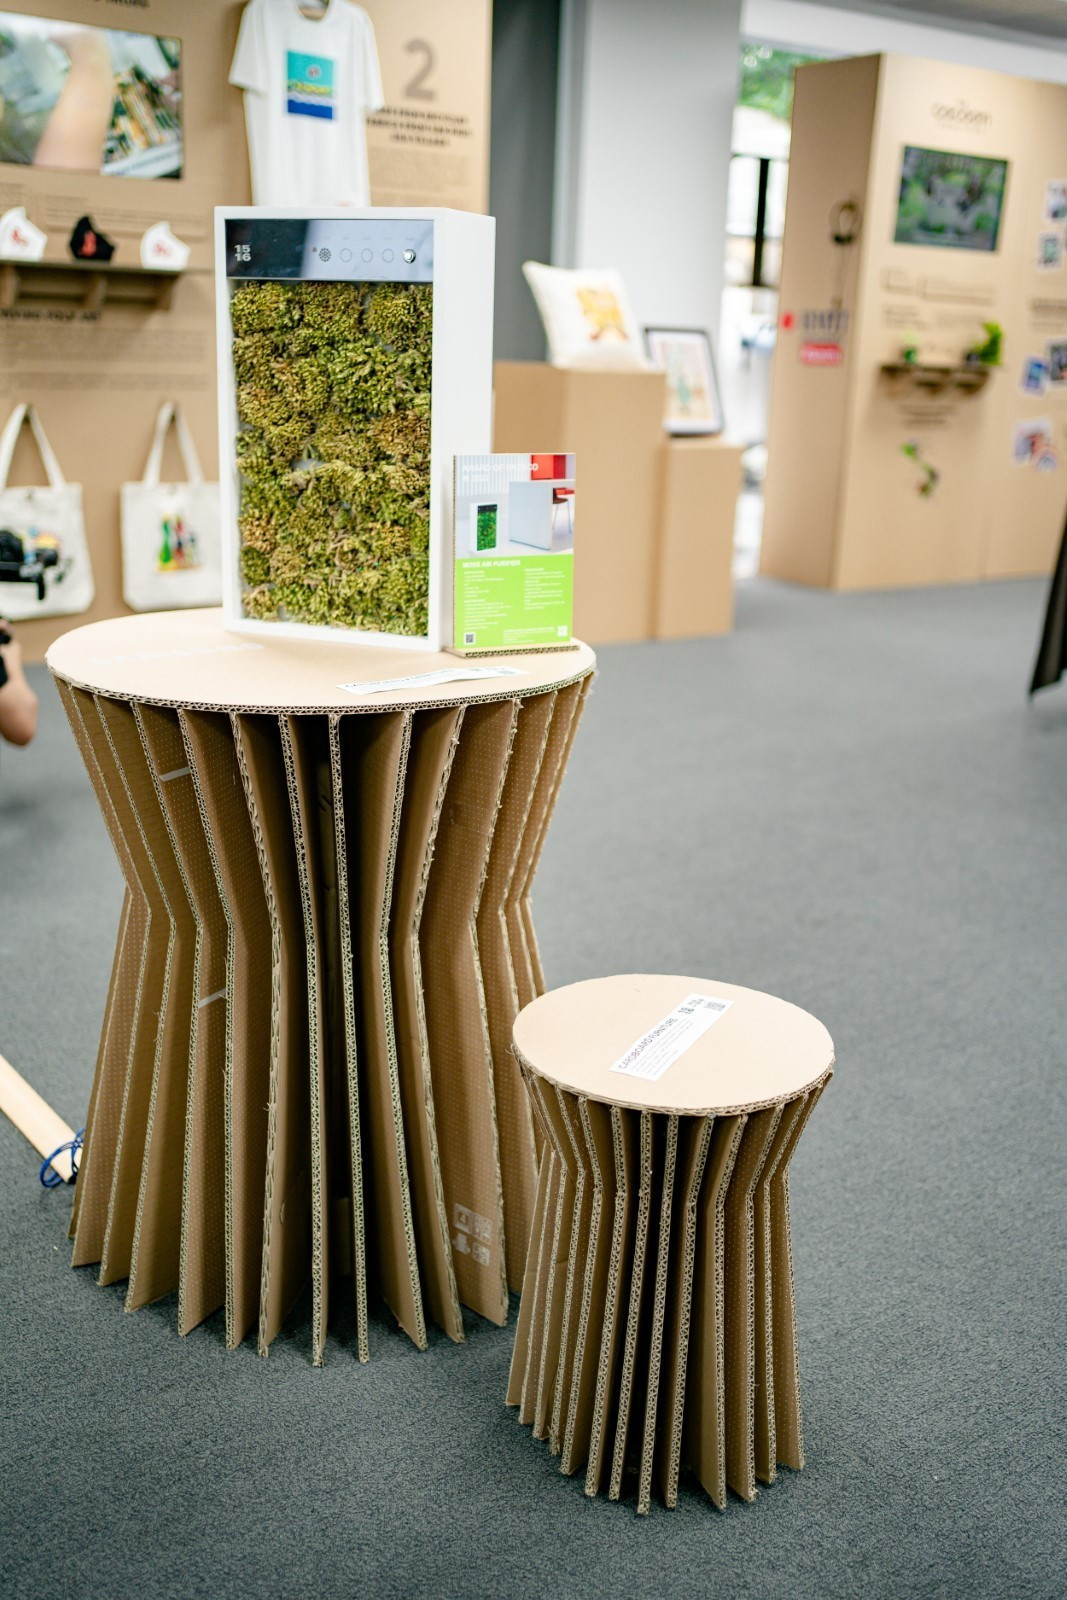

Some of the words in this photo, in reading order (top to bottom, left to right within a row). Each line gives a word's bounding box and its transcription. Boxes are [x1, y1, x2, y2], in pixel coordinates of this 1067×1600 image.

[404, 37, 437, 101] 2
[235, 244, 251, 253] 15
[235, 252, 252, 262] 16
[493, 559, 521, 567] PURIFIER
[618, 1035, 653, 1069] CARDBOARD
